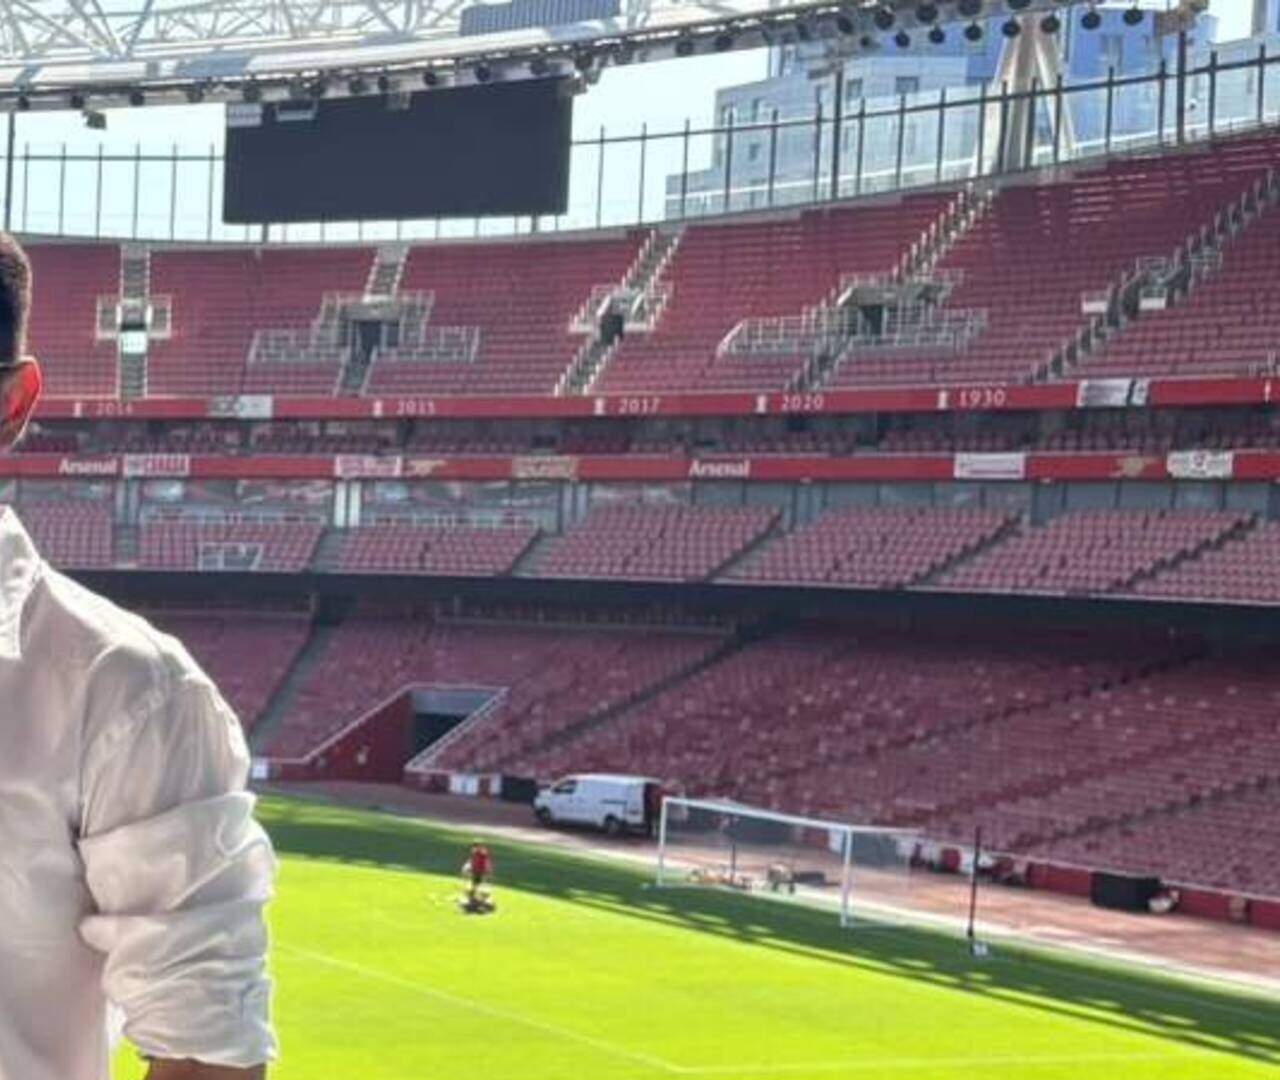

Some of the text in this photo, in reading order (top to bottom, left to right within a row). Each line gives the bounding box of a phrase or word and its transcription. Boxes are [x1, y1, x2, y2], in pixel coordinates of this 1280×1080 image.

[619, 398, 660, 414] 2017
[781, 394, 824, 410] 2020
[958, 389, 1006, 407] 1930
[59, 458, 117, 475] Arsenal
[689, 459, 750, 478] Arsenal
